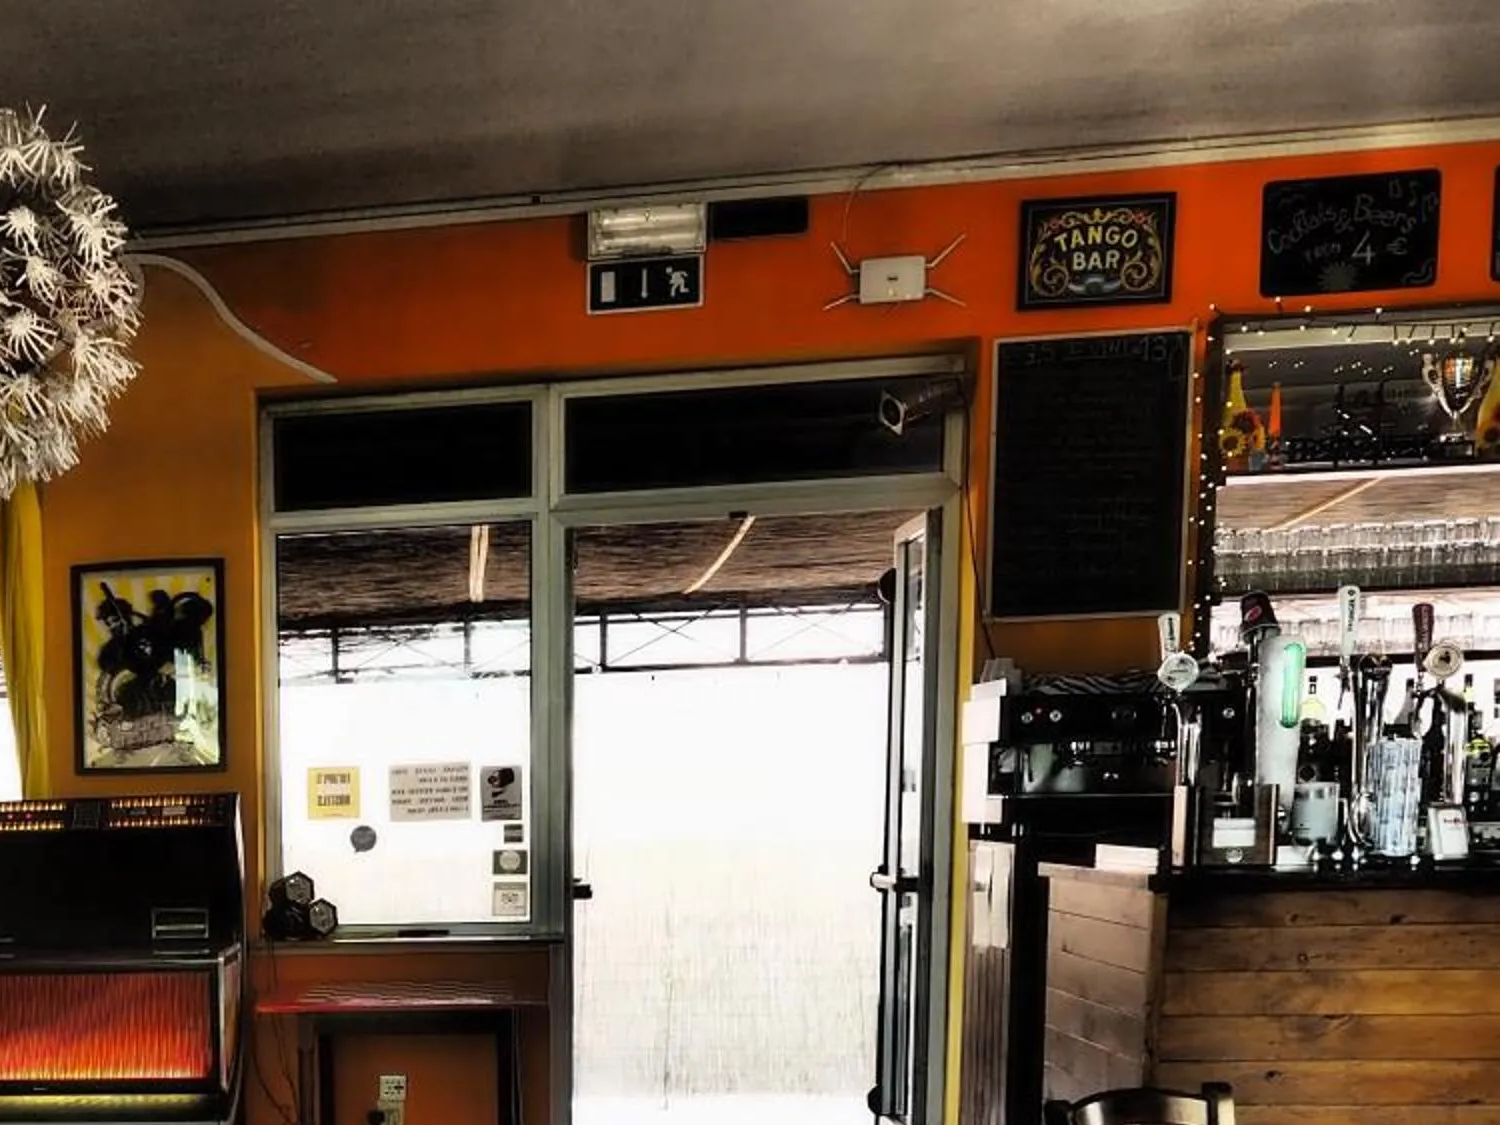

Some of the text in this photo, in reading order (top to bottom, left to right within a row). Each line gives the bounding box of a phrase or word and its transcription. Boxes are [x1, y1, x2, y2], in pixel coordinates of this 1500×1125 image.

[1353, 192, 1417, 235] Beers
[1054, 226, 1138, 252] TANGO
[1350, 229, 1376, 266] 4
[1073, 250, 1121, 271] BAR
